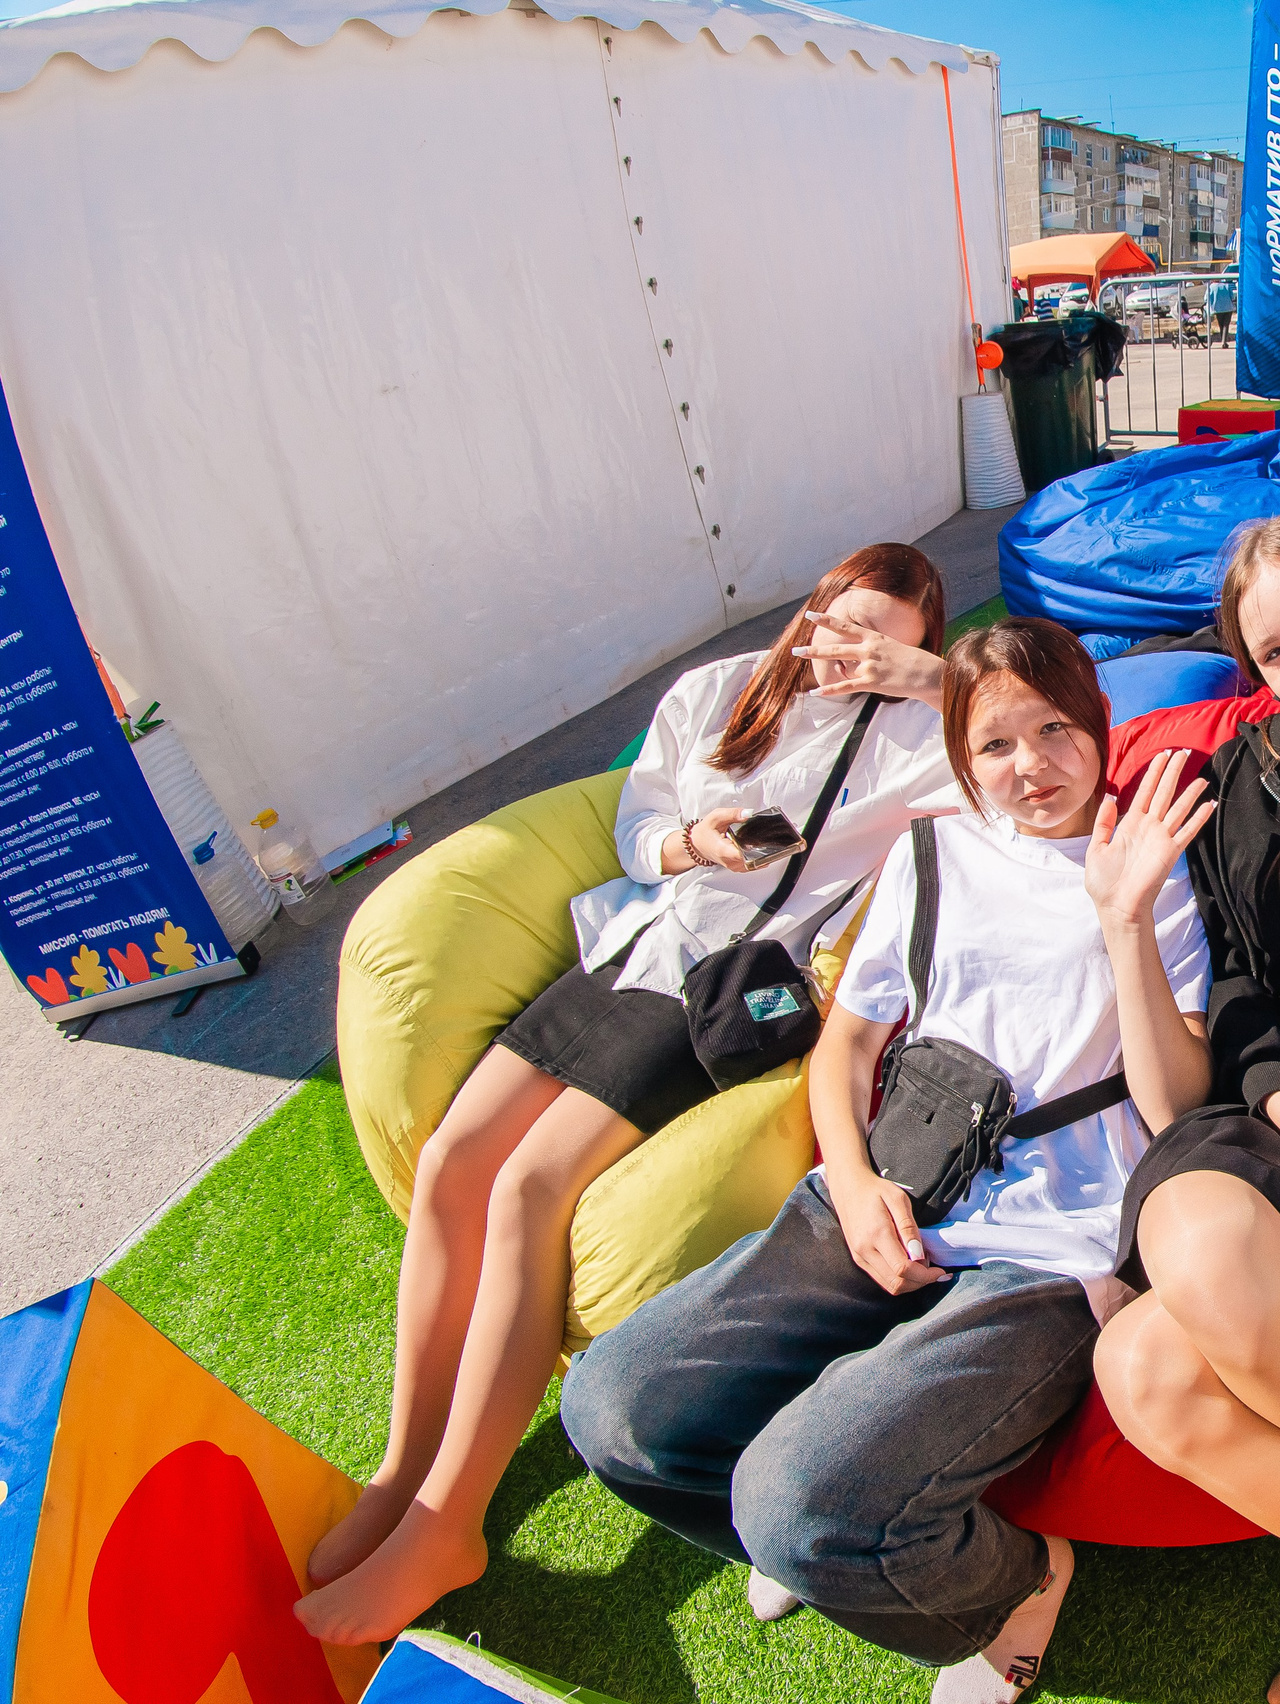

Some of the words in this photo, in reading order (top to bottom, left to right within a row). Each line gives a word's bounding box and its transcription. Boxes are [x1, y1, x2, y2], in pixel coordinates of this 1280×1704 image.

[25, 682, 53, 701] суббота
[61, 748, 89, 765] суббота
[81, 820, 107, 833] суббота
[117, 865, 144, 879] суббота
[38, 933, 80, 955] МИССИЯ
[82, 919, 130, 940] ПОМОГАТЬ
[128, 906, 171, 927] ЛЮДЯМ!
[1009, 1655, 1040, 1689] FILA
